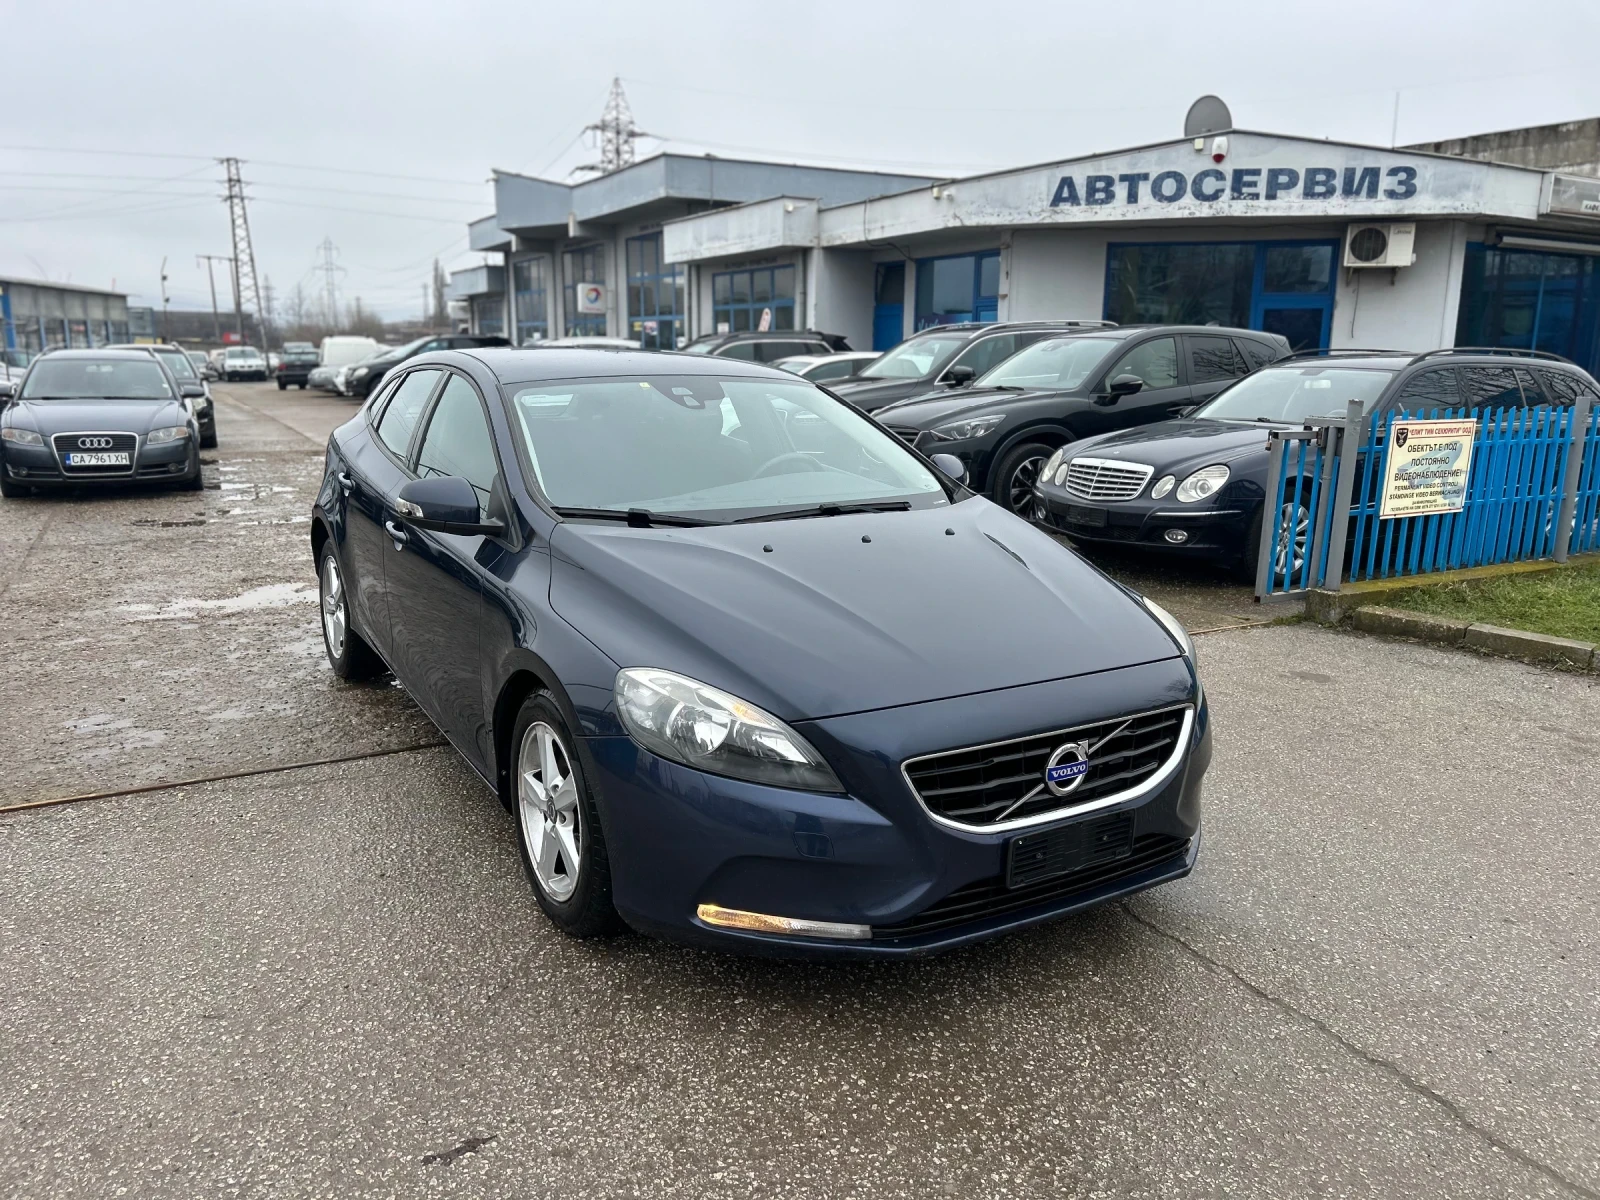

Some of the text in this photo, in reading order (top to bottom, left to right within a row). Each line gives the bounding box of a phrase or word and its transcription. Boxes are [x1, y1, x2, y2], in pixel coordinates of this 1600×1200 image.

[1049, 166, 1418, 207] АВТОСЕРВИЗ
[1407, 442, 1458, 453] ОБЕКТЪТ Е ПОД
[72, 454, 127, 464] CA 7961 XH
[1410, 456, 1450, 467] ПОСТОЯННО
[1394, 469, 1462, 482] ВИДЕОНАБЛЮДЕНИЕ!
[1051, 764, 1086, 778] VOLVO
